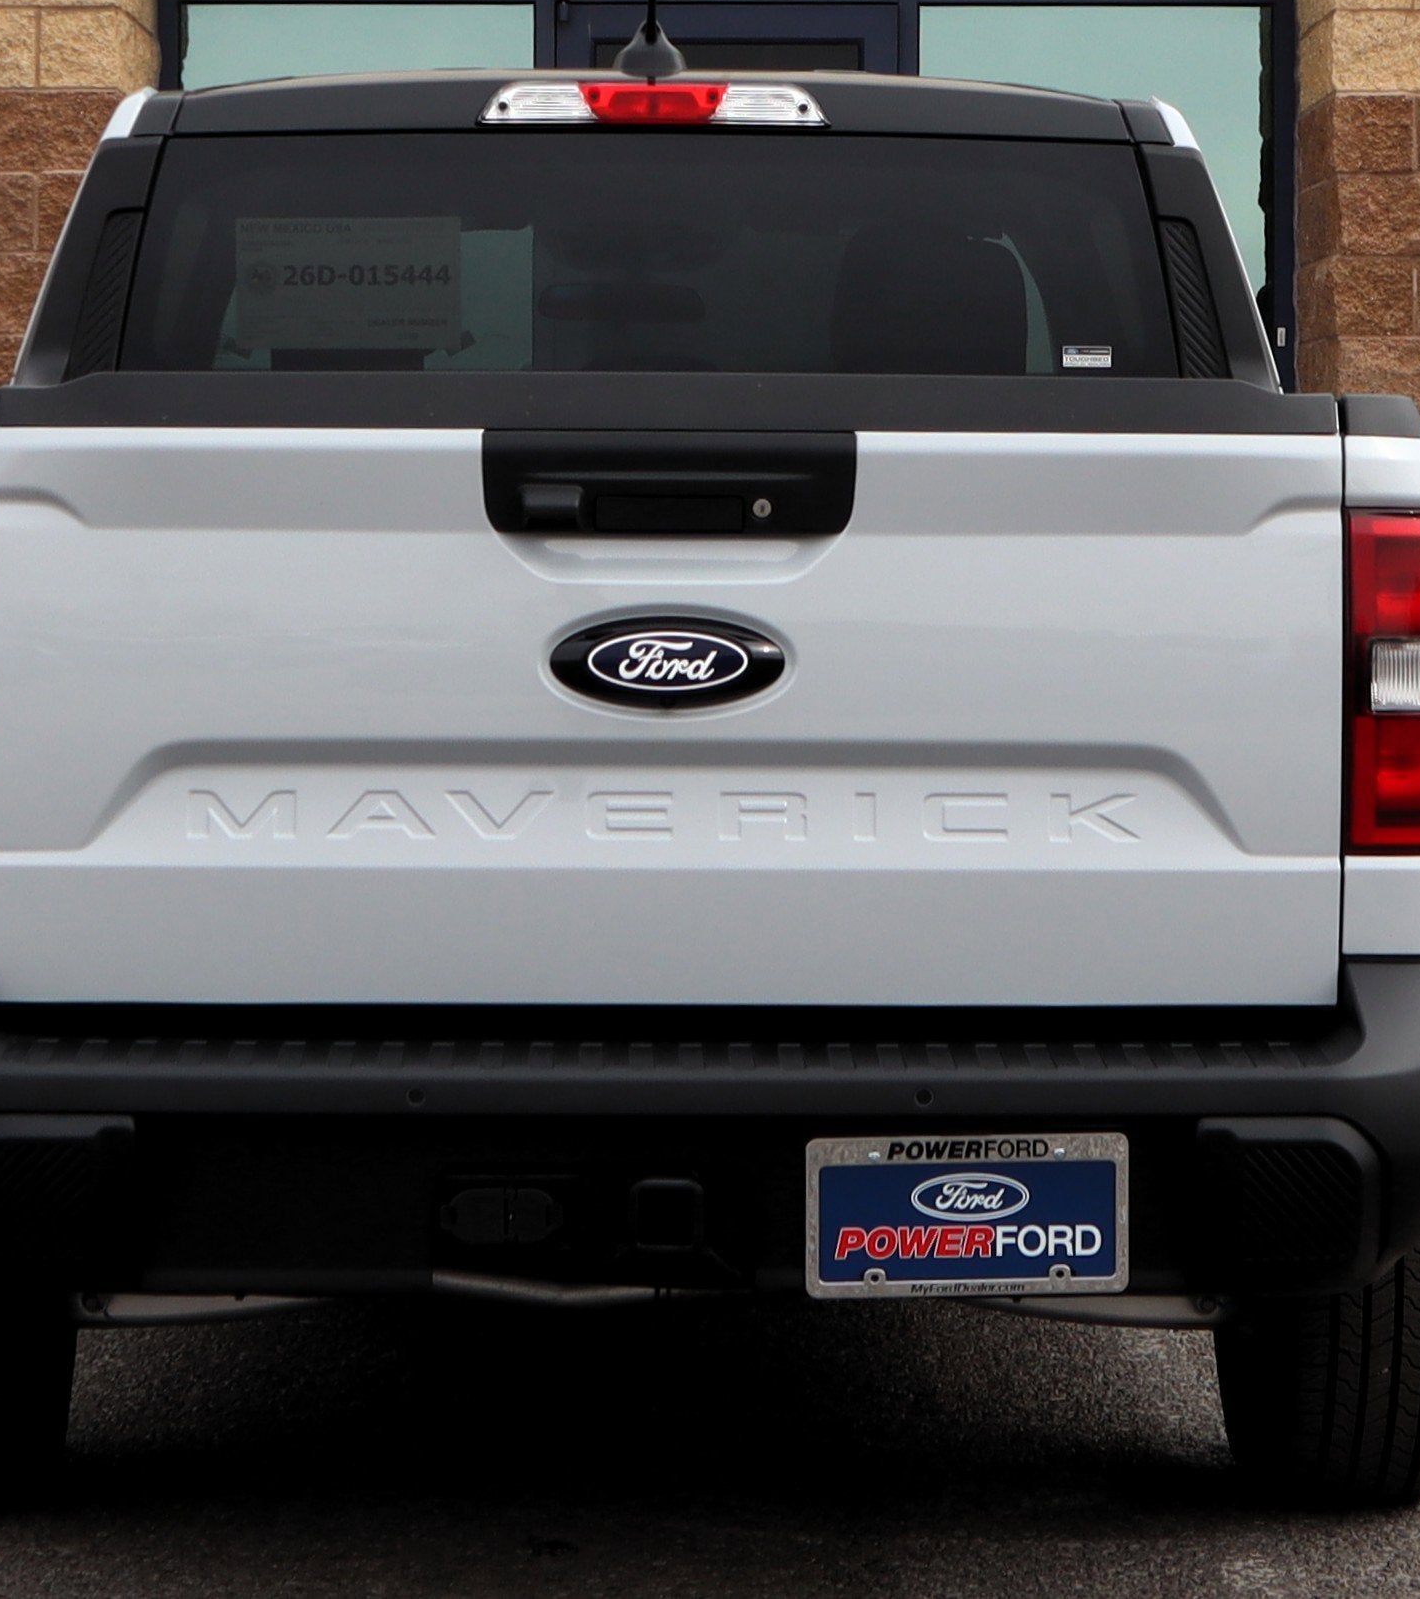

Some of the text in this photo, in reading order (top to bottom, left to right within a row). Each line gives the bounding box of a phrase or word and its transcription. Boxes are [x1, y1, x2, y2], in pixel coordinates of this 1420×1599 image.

[240, 223, 352, 234] NEW MEXICO USA
[282, 264, 452, 287] 26D-015444
[618, 639, 718, 681] Ford
[185, 788, 1143, 843] MAVERICK
[886, 1138, 1050, 1161] POWERFORD
[935, 1181, 1006, 1211] Ford
[834, 1223, 1103, 1261] POWERFORD
